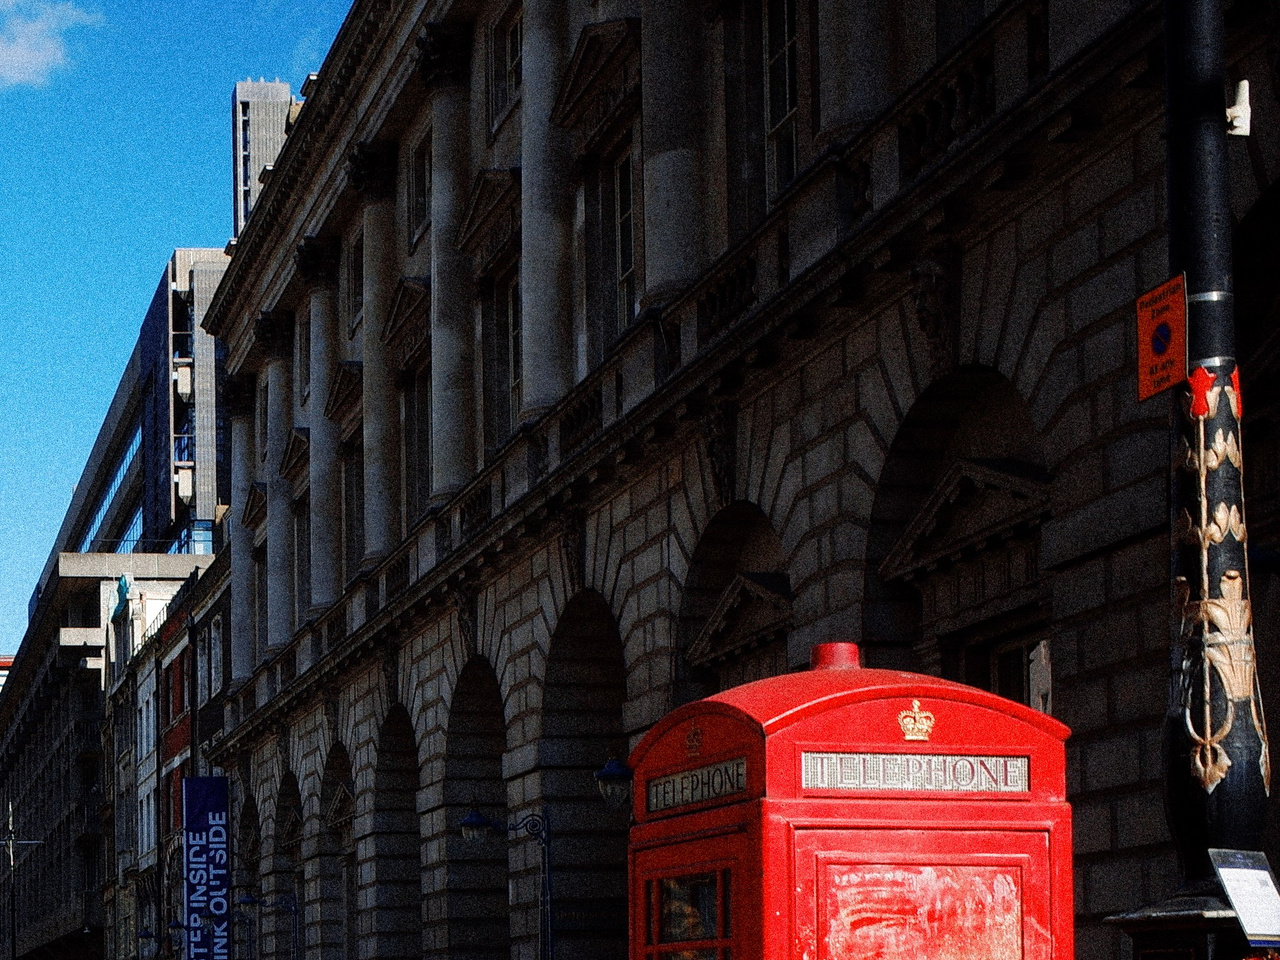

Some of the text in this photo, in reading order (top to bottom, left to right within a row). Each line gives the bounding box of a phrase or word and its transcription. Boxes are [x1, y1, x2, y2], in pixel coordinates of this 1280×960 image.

[653, 761, 745, 808] TELEPHONE
[809, 756, 1021, 788] TELEPHONE
[189, 831, 208, 908] INSIDE
[209, 811, 228, 915] OUTSIDE
